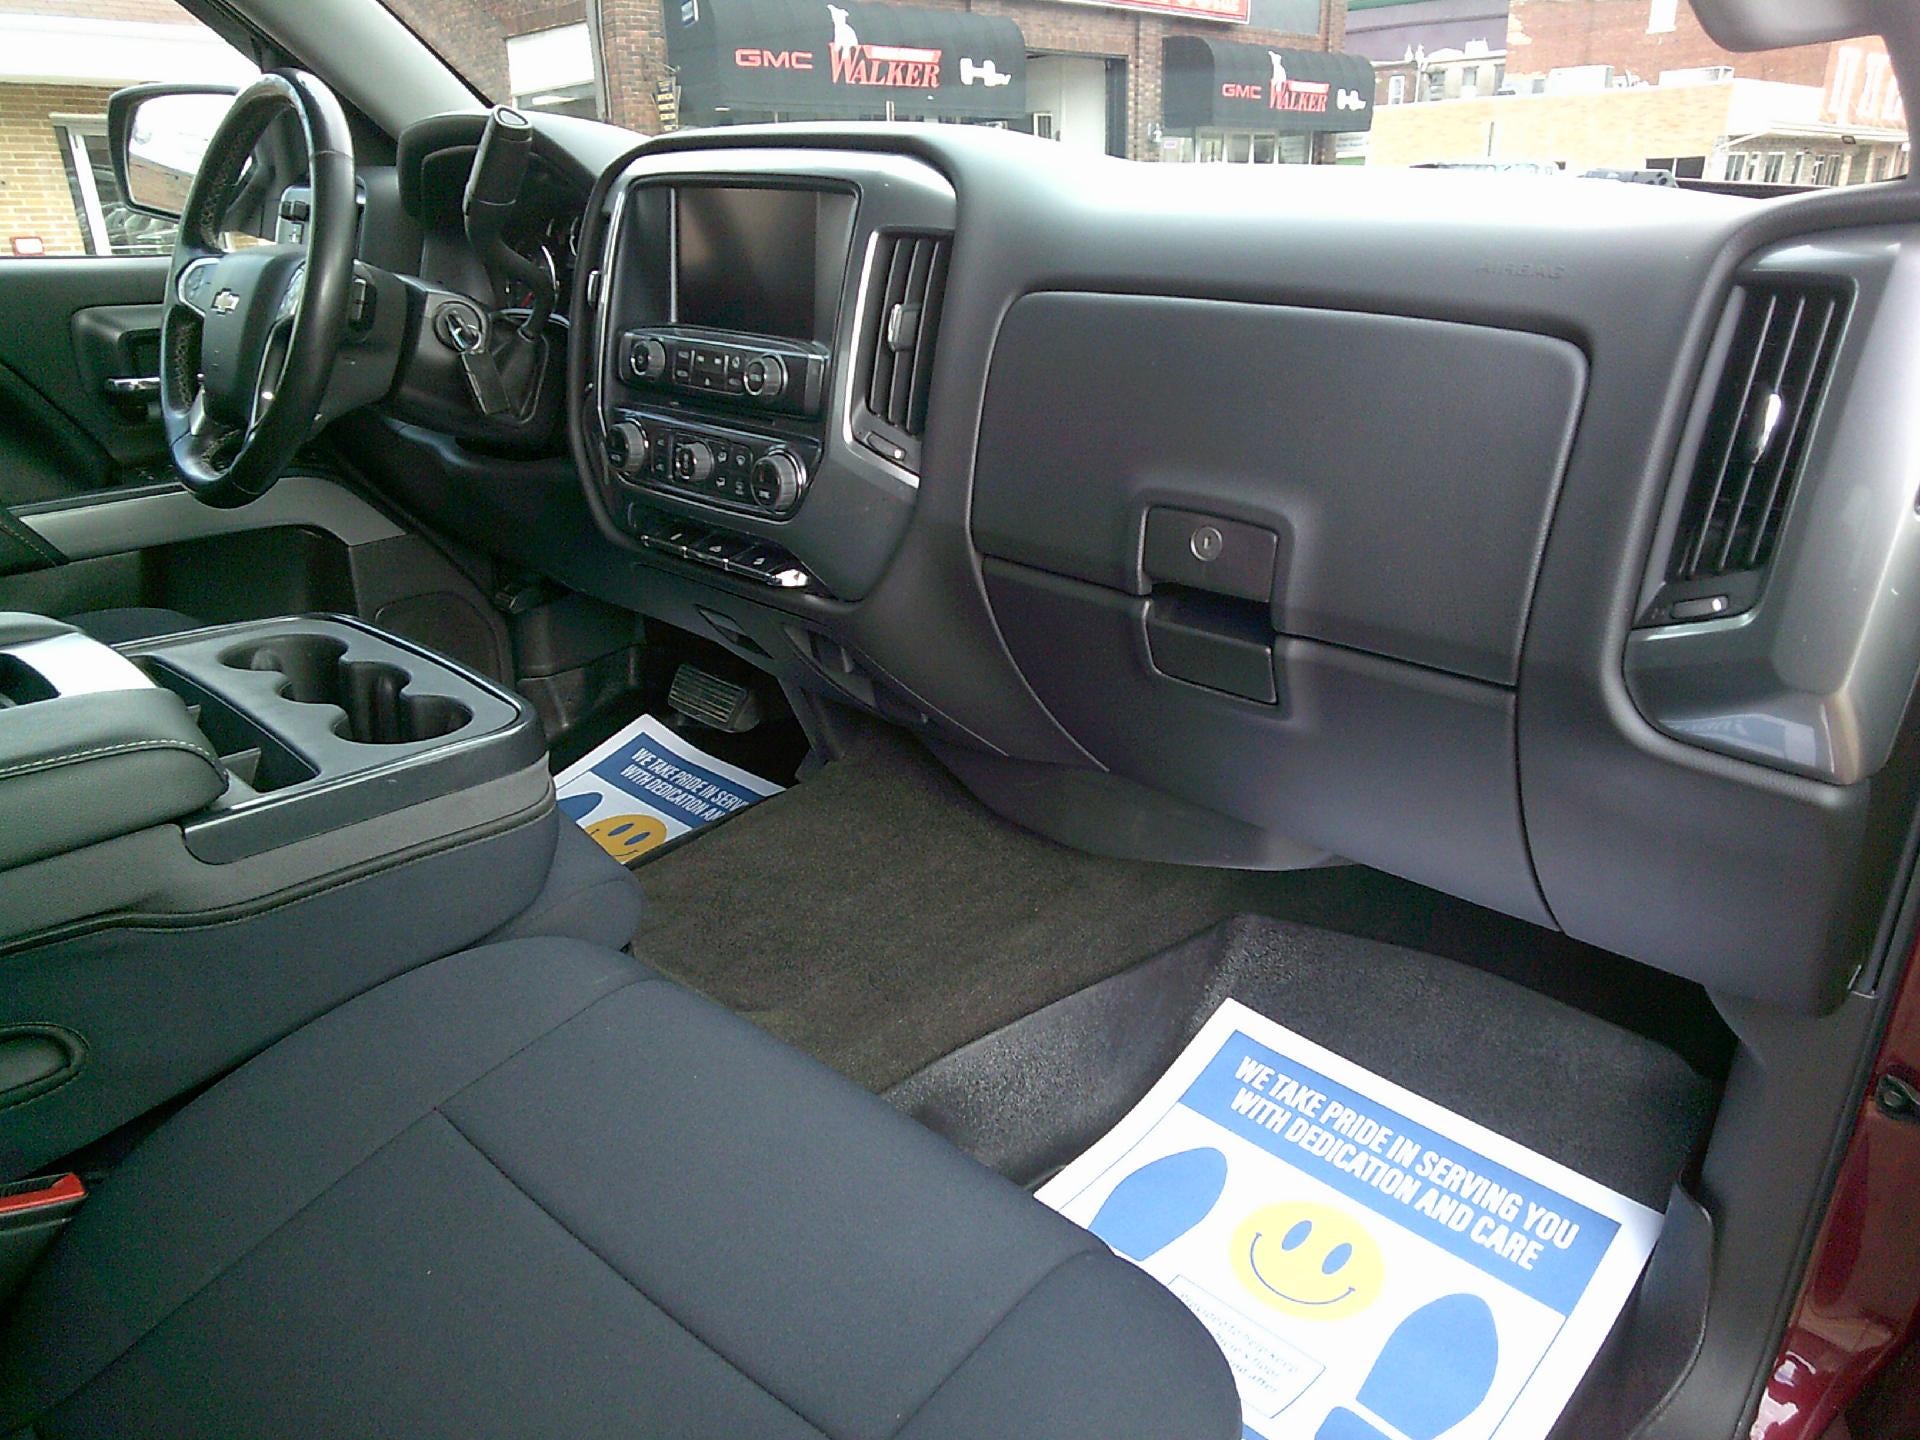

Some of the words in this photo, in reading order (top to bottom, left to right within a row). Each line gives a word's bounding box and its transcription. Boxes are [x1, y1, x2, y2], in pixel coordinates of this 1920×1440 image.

[735, 48, 813, 70] GMC
[828, 42, 941, 88] WALKER
[1222, 83, 1262, 99] GMC
[1269, 79, 1328, 112] WALKER
[620, 763, 655, 786] WITH
[644, 778, 709, 815] DEDICATION
[631, 747, 657, 766] WE
[647, 758, 680, 779] TAKE
[670, 771, 709, 793] PRIDE
[699, 784, 720, 799] IN
[1234, 1055, 1275, 1091] WE
[1268, 1073, 1328, 1119] TAKE
[1319, 1100, 1394, 1153] PRIDE
[1386, 1135, 1422, 1169] IN
[1415, 1150, 1524, 1223] SERVING
[1523, 1201, 1580, 1249] YOU
[1231, 1087, 1292, 1134] WITH
[1284, 1117, 1422, 1205] DEDICATION
[1413, 1187, 1475, 1232] AND
[1470, 1215, 1545, 1271] CARE
